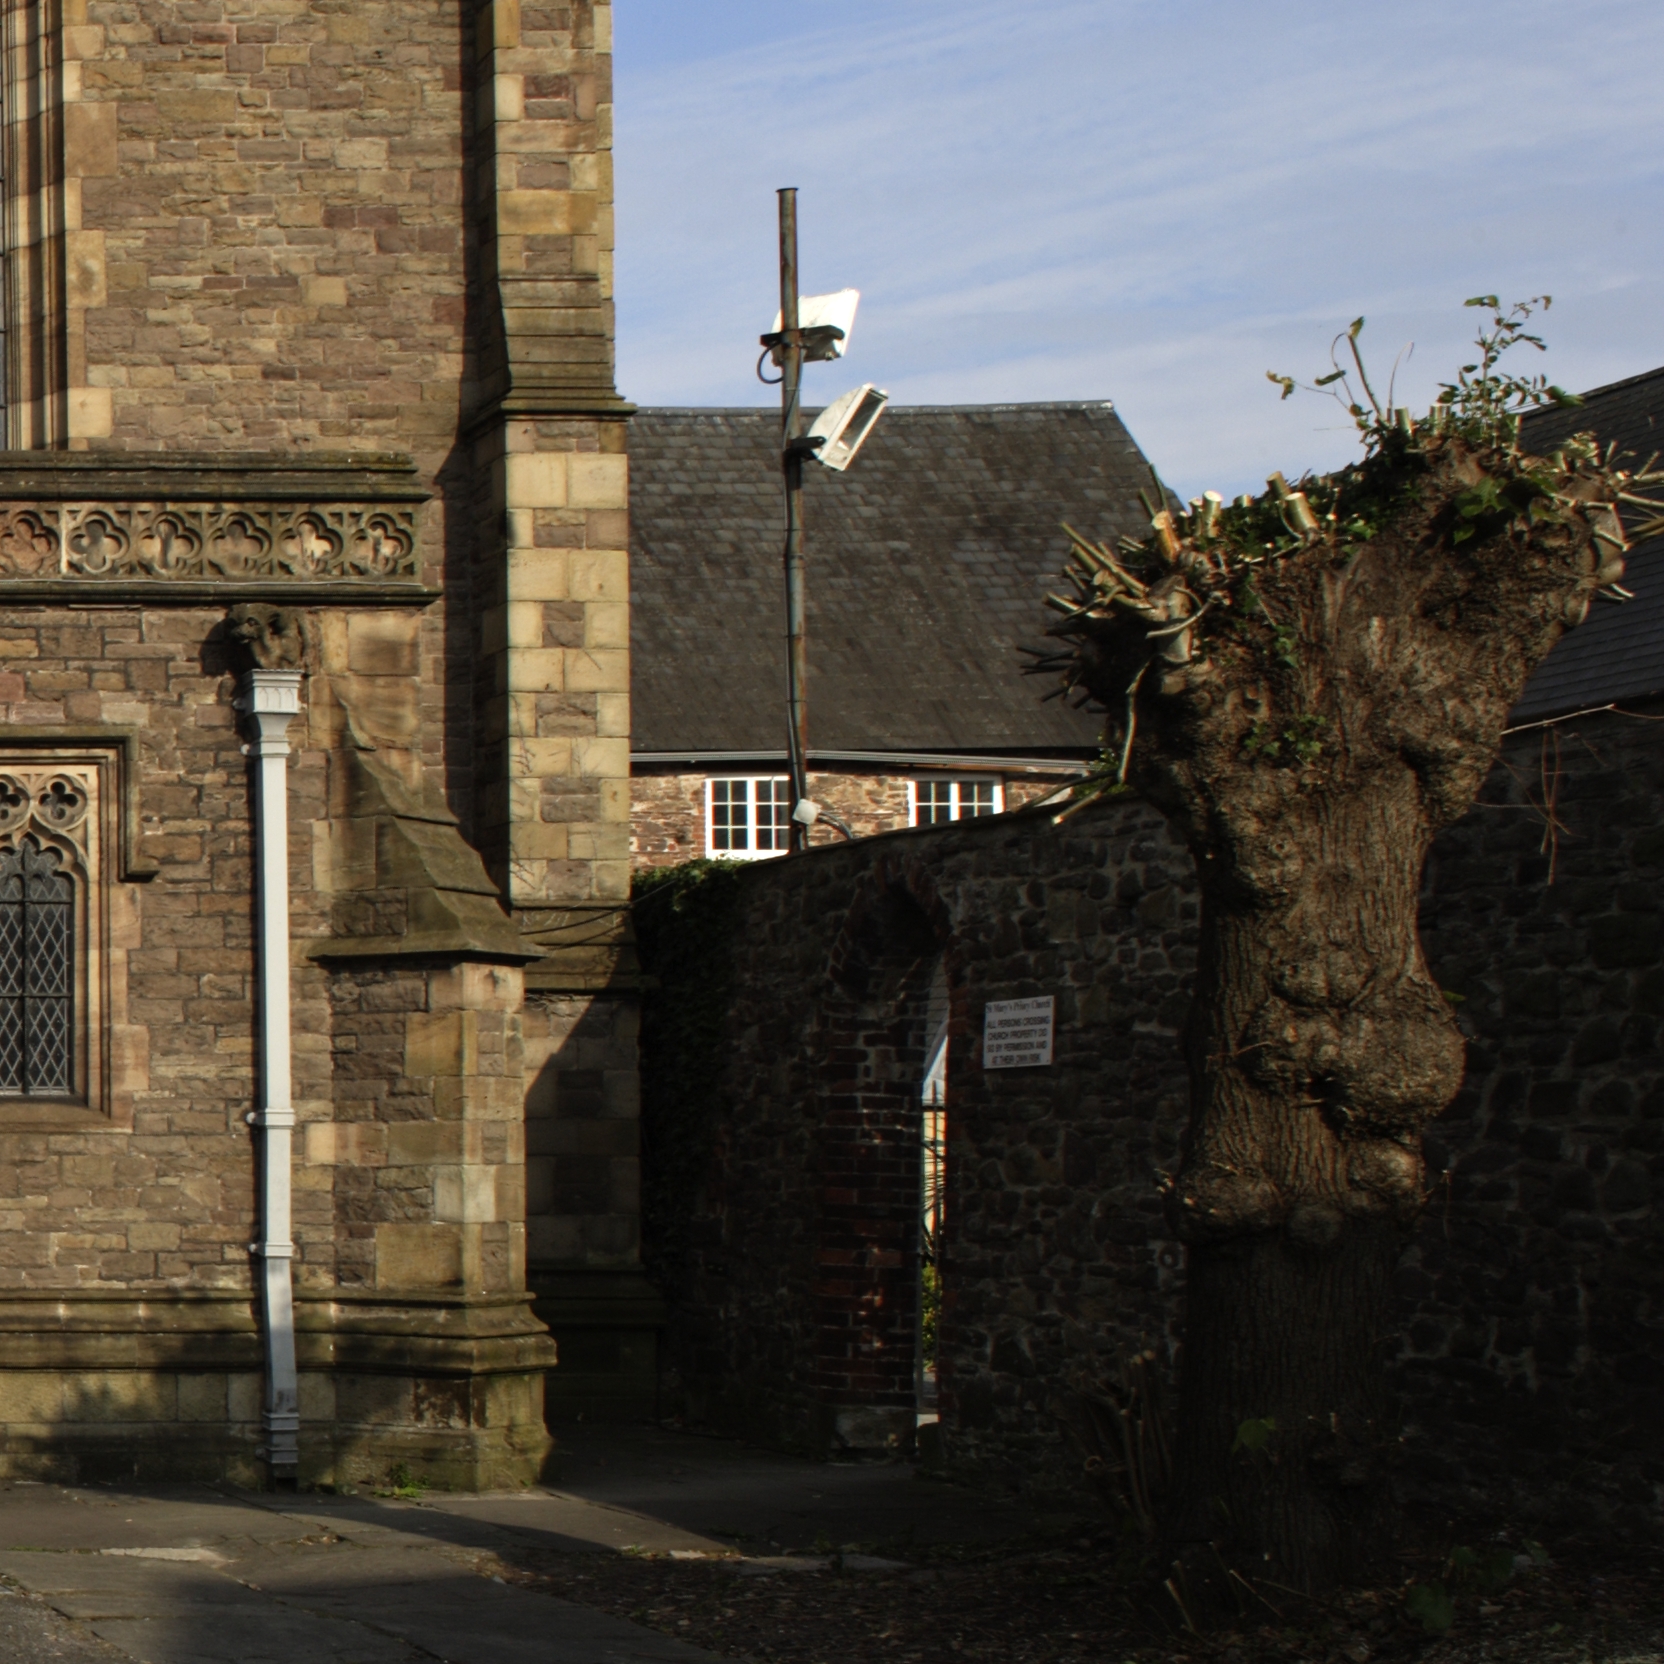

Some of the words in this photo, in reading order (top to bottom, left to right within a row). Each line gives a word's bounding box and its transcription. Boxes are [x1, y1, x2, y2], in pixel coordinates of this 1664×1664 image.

[998, 1018, 1022, 1028] PERSONS
[1023, 1016, 1051, 1026] CROSSING
[988, 1030, 1009, 1041] CHURCH
[1010, 1029, 1037, 1039] PROPERTY
[1004, 1041, 1035, 1052] PERMISSION
